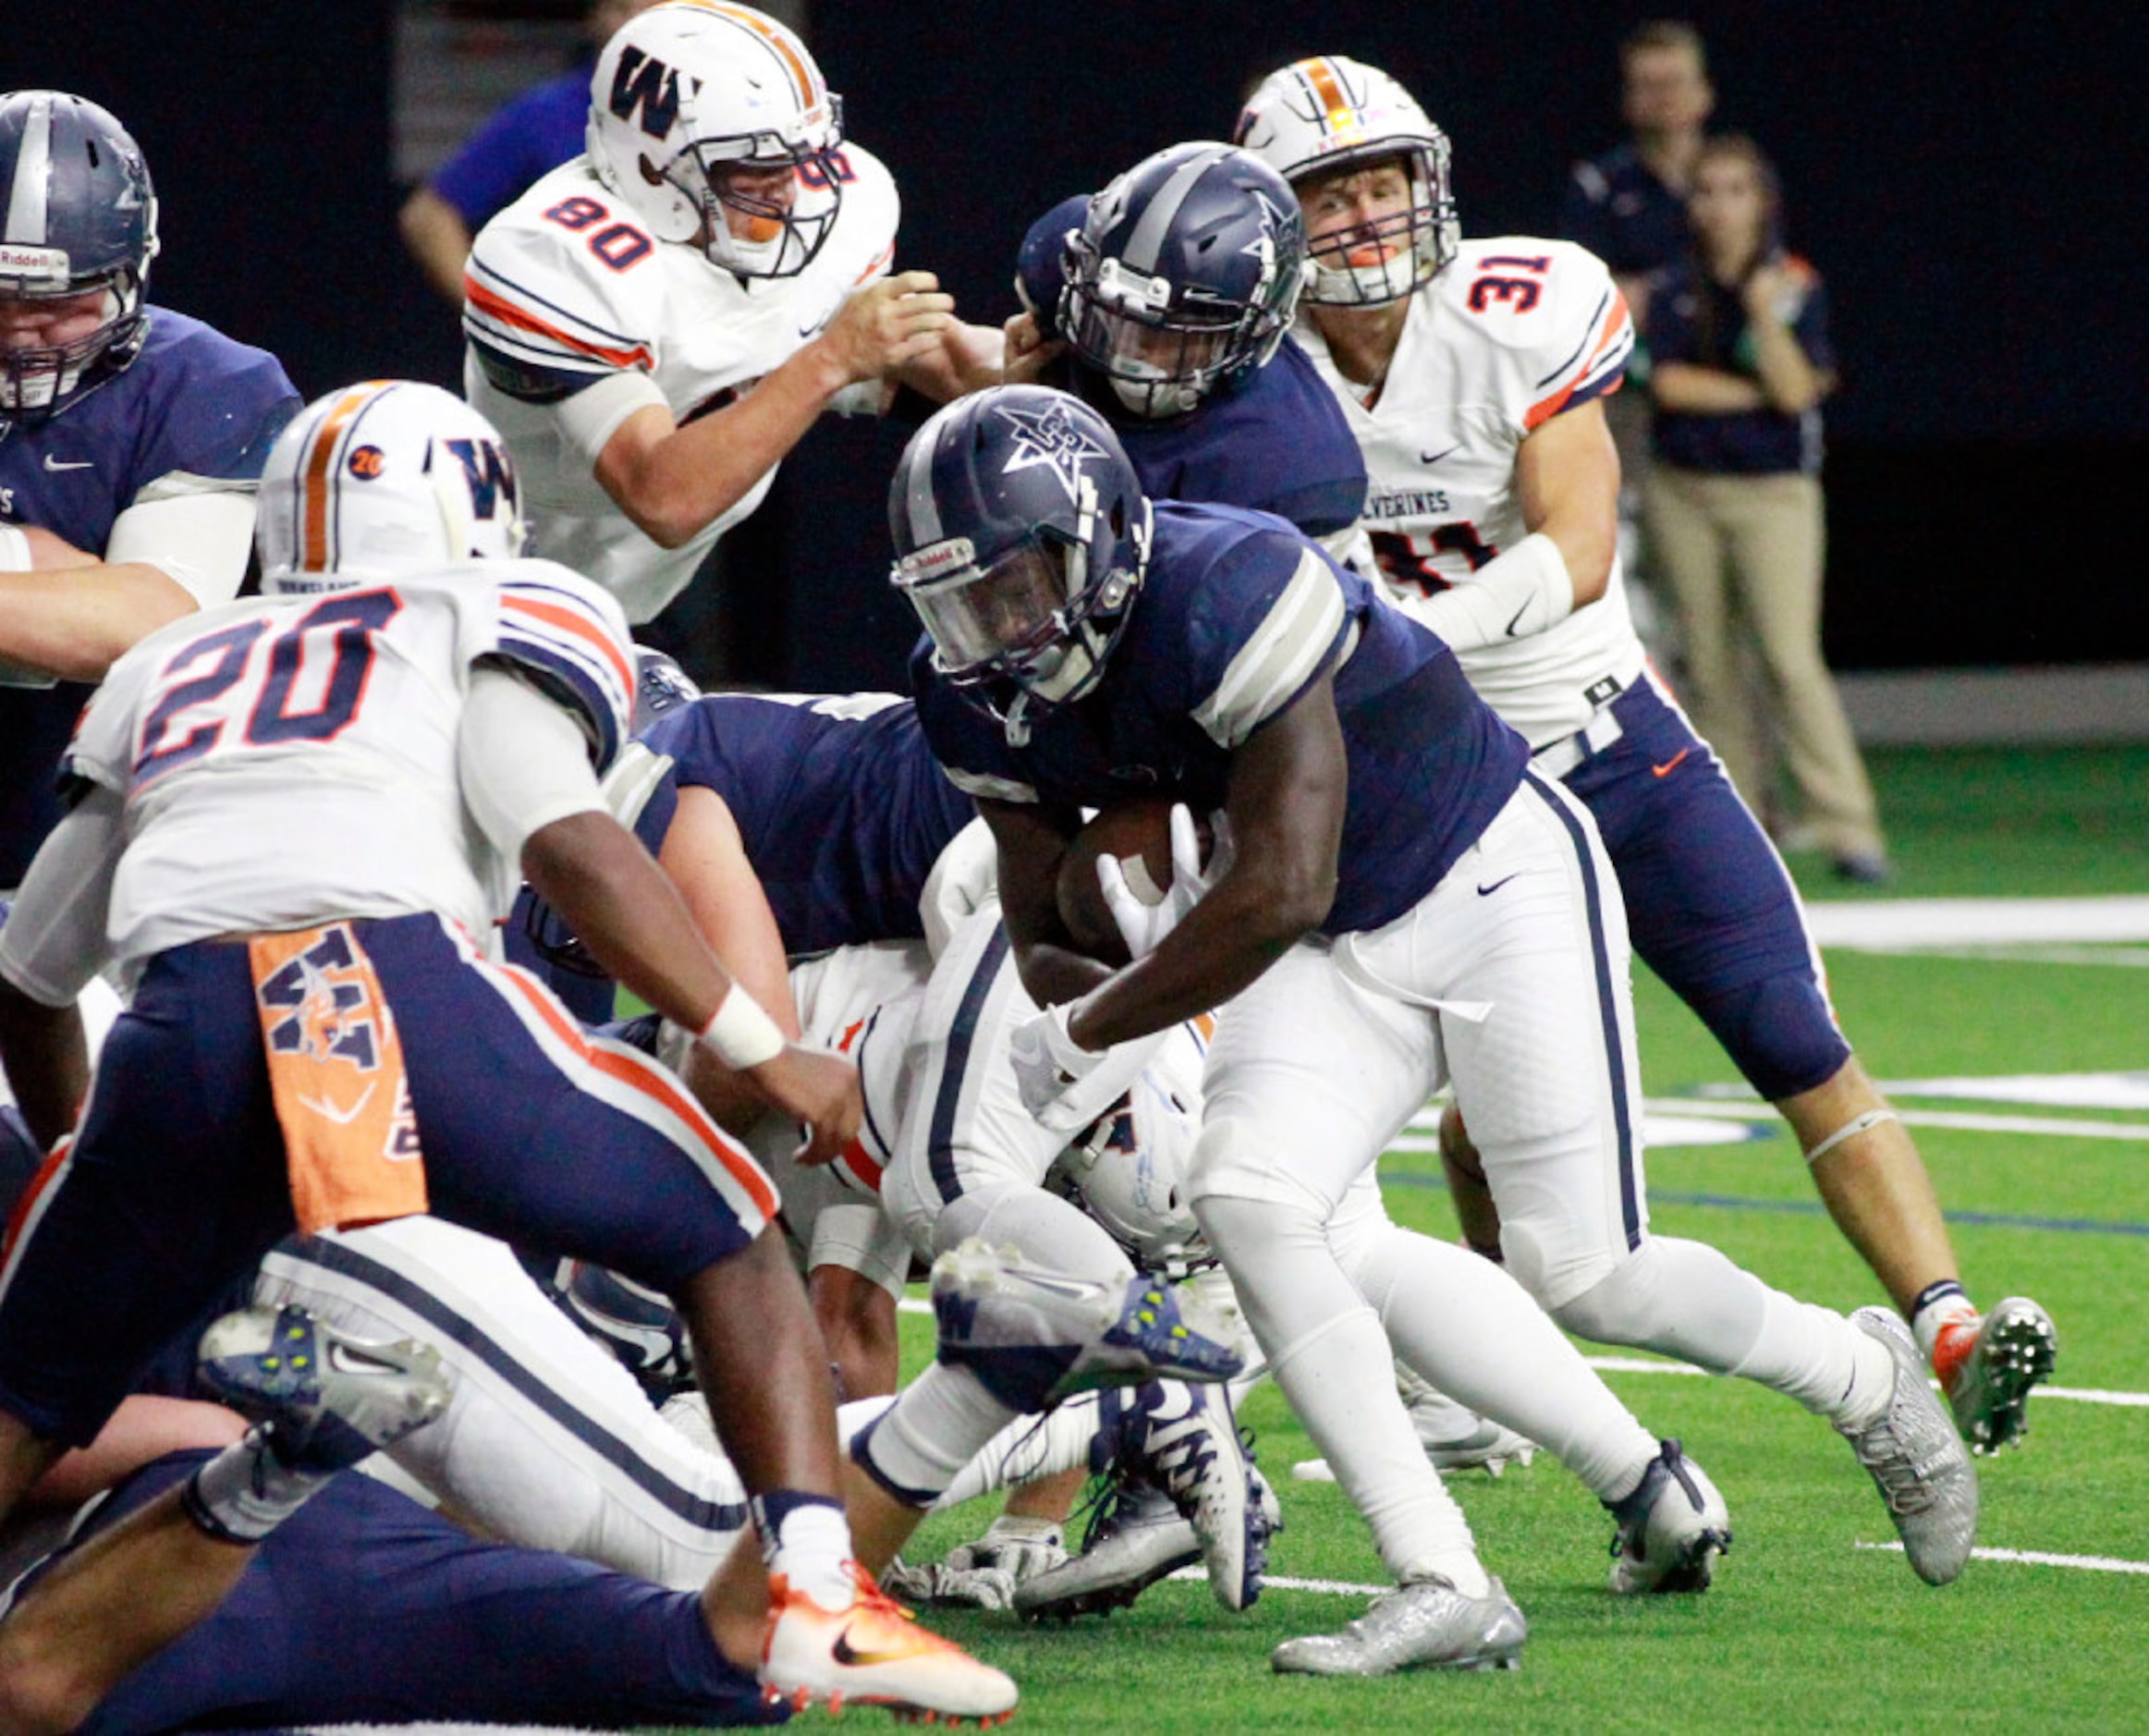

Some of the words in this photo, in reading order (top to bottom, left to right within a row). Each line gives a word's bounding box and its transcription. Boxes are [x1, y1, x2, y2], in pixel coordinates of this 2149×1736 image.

[1, 251, 49, 267] Riddell
[540, 195, 653, 275] 80
[1466, 256, 1553, 315] 31
[122, 584, 405, 804] 20
